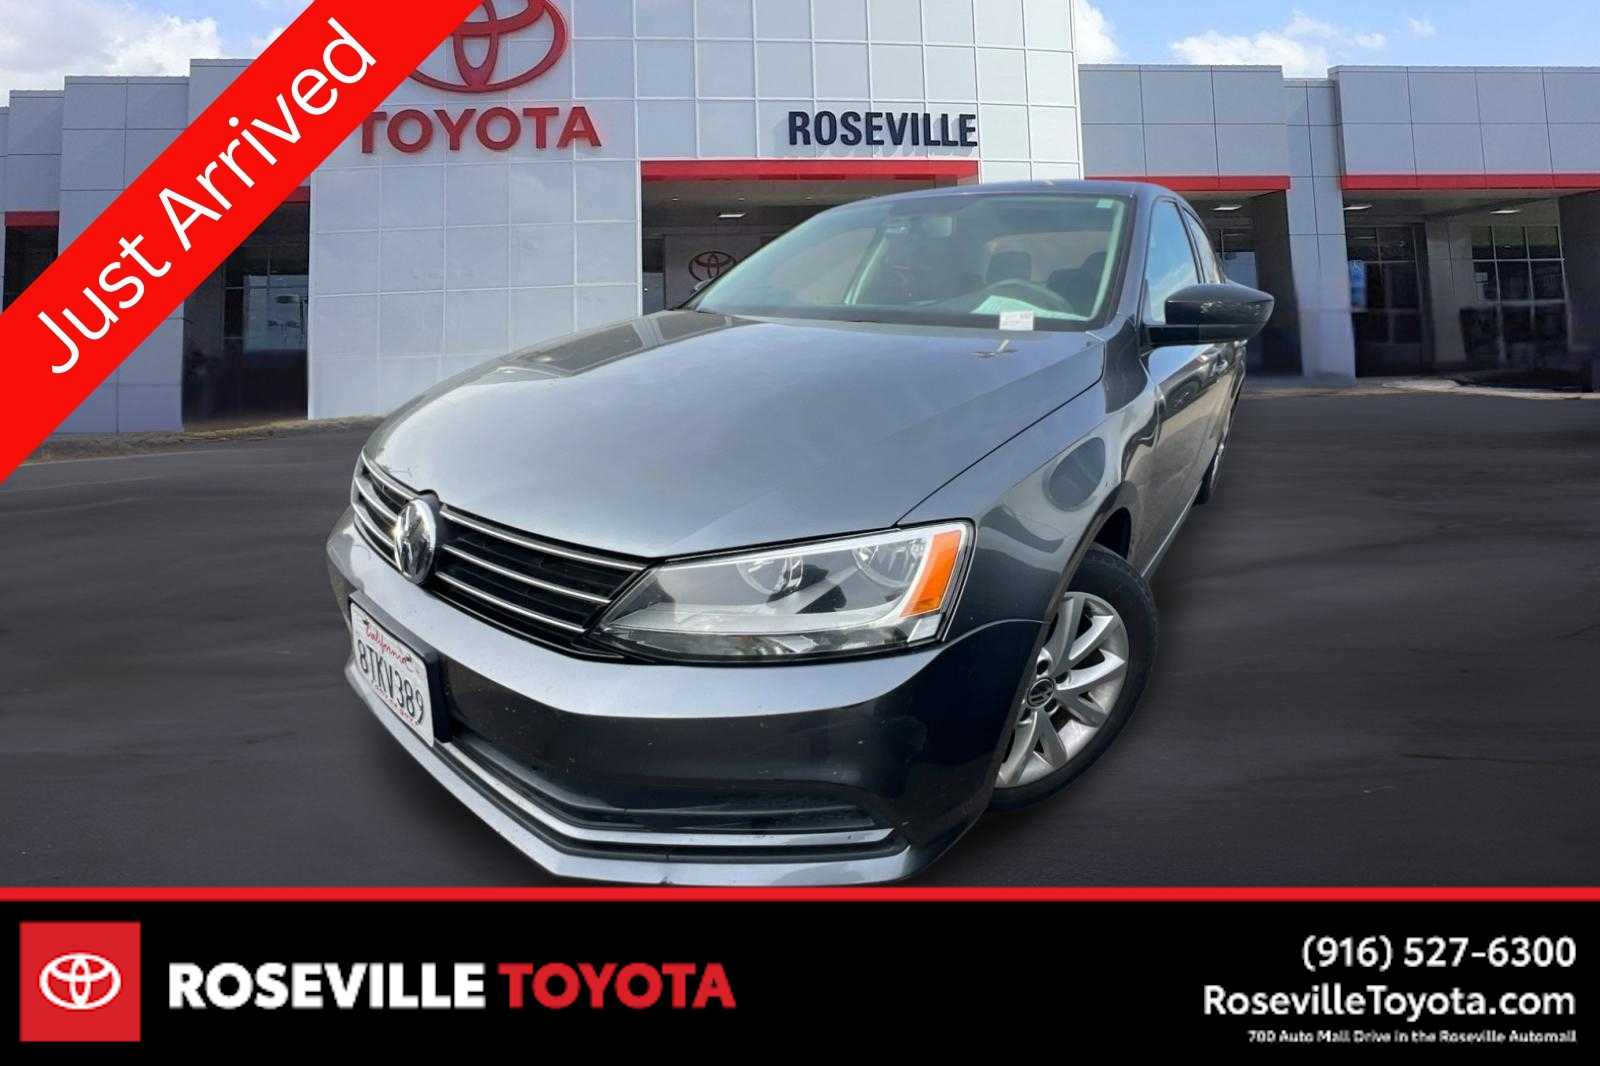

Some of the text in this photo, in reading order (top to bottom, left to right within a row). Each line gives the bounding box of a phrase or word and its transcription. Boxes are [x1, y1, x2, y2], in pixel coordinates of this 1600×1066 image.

[360, 106, 603, 154] TOYOTA
[788, 111, 978, 147] ROSEVILLE
[358, 639, 424, 725] 8TKV389
